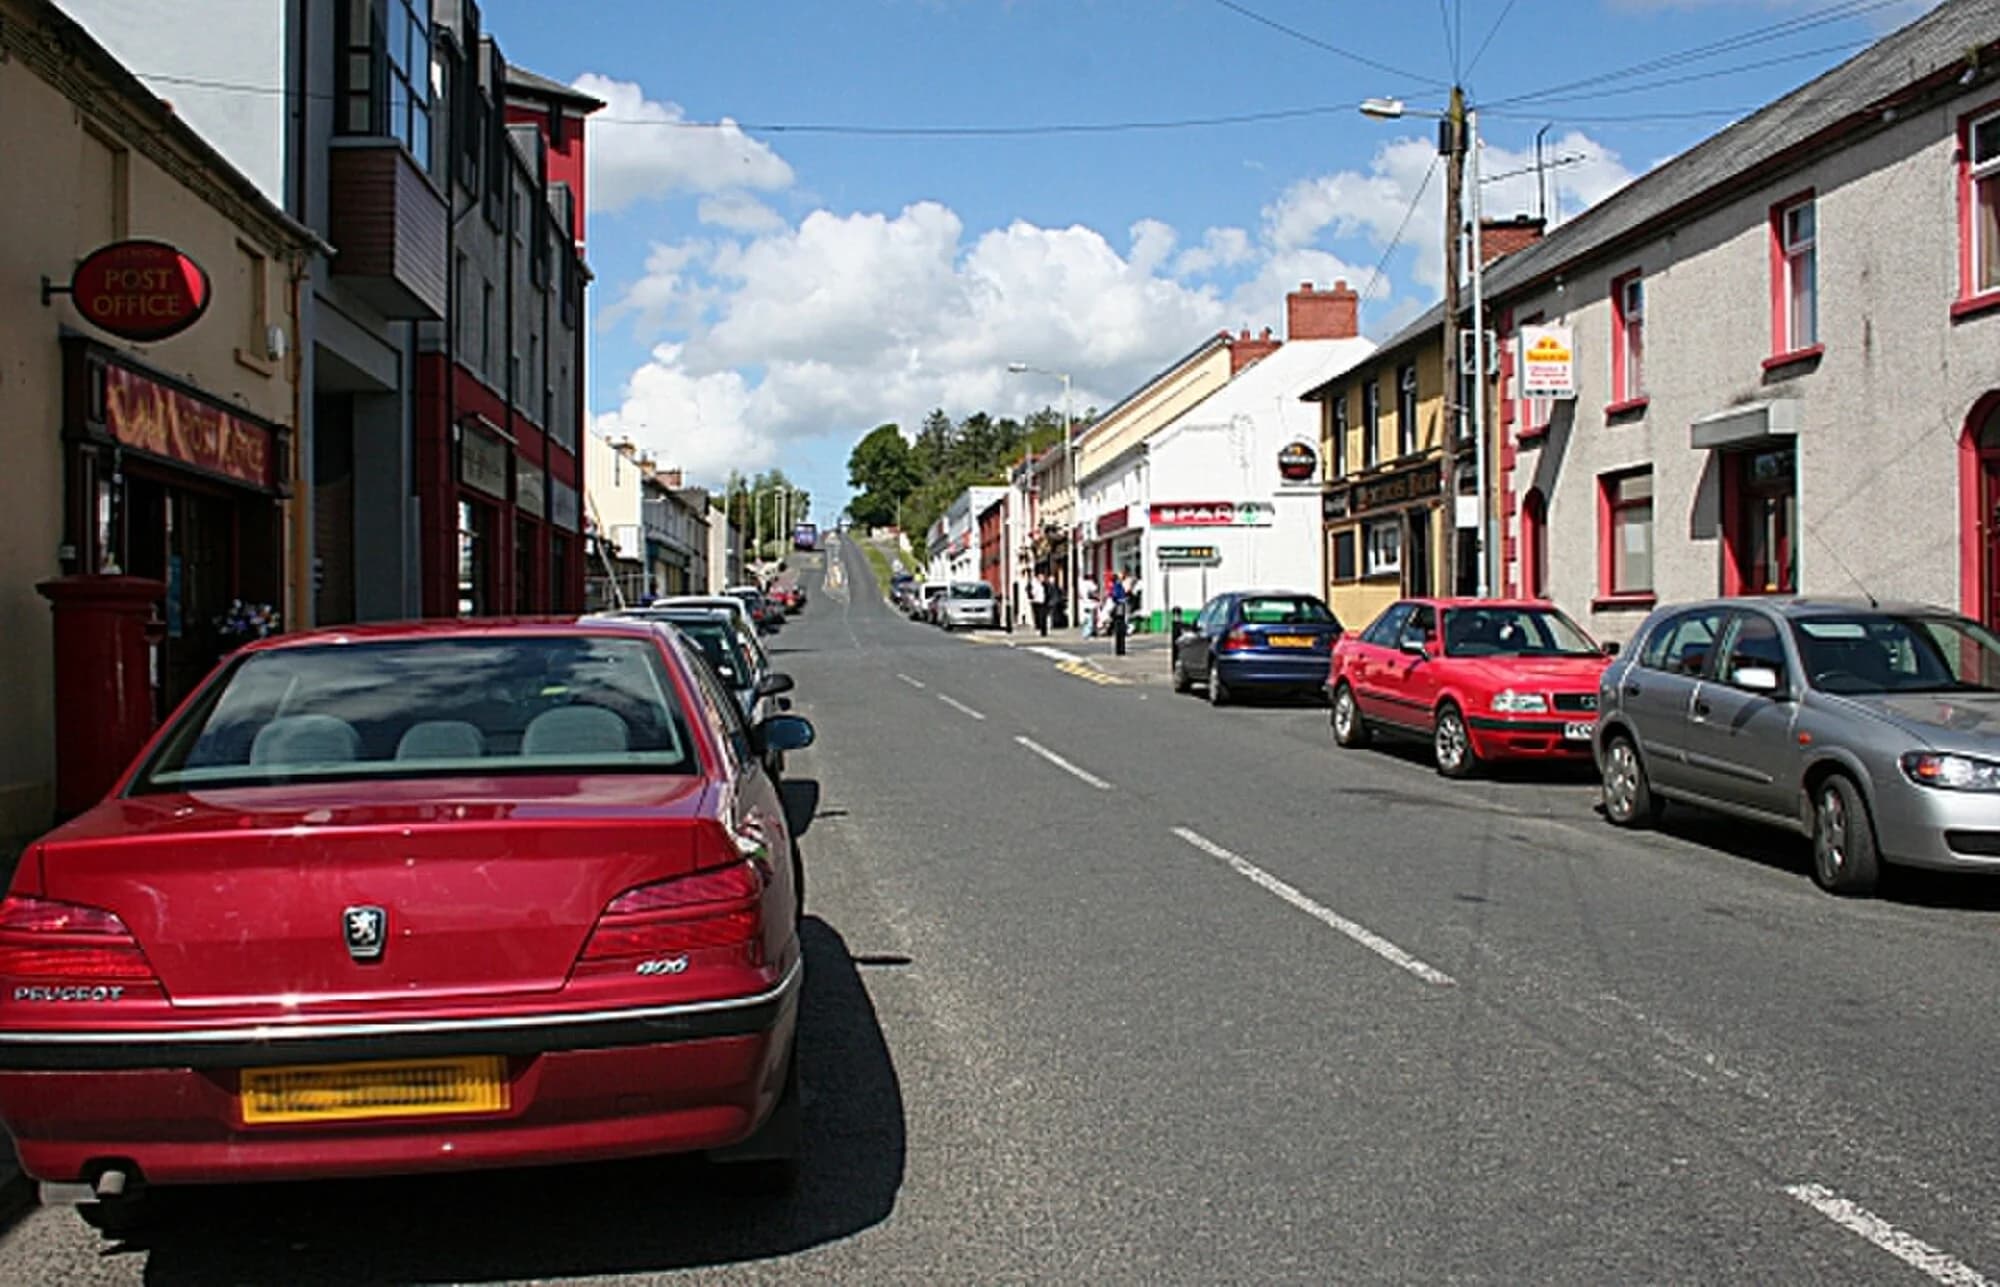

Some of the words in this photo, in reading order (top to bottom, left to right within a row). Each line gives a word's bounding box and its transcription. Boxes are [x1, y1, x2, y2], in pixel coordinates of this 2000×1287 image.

[105, 270, 171, 289] POST
[93, 295, 180, 317] OFFICE
[14, 986, 124, 1000] PEUGEOT
